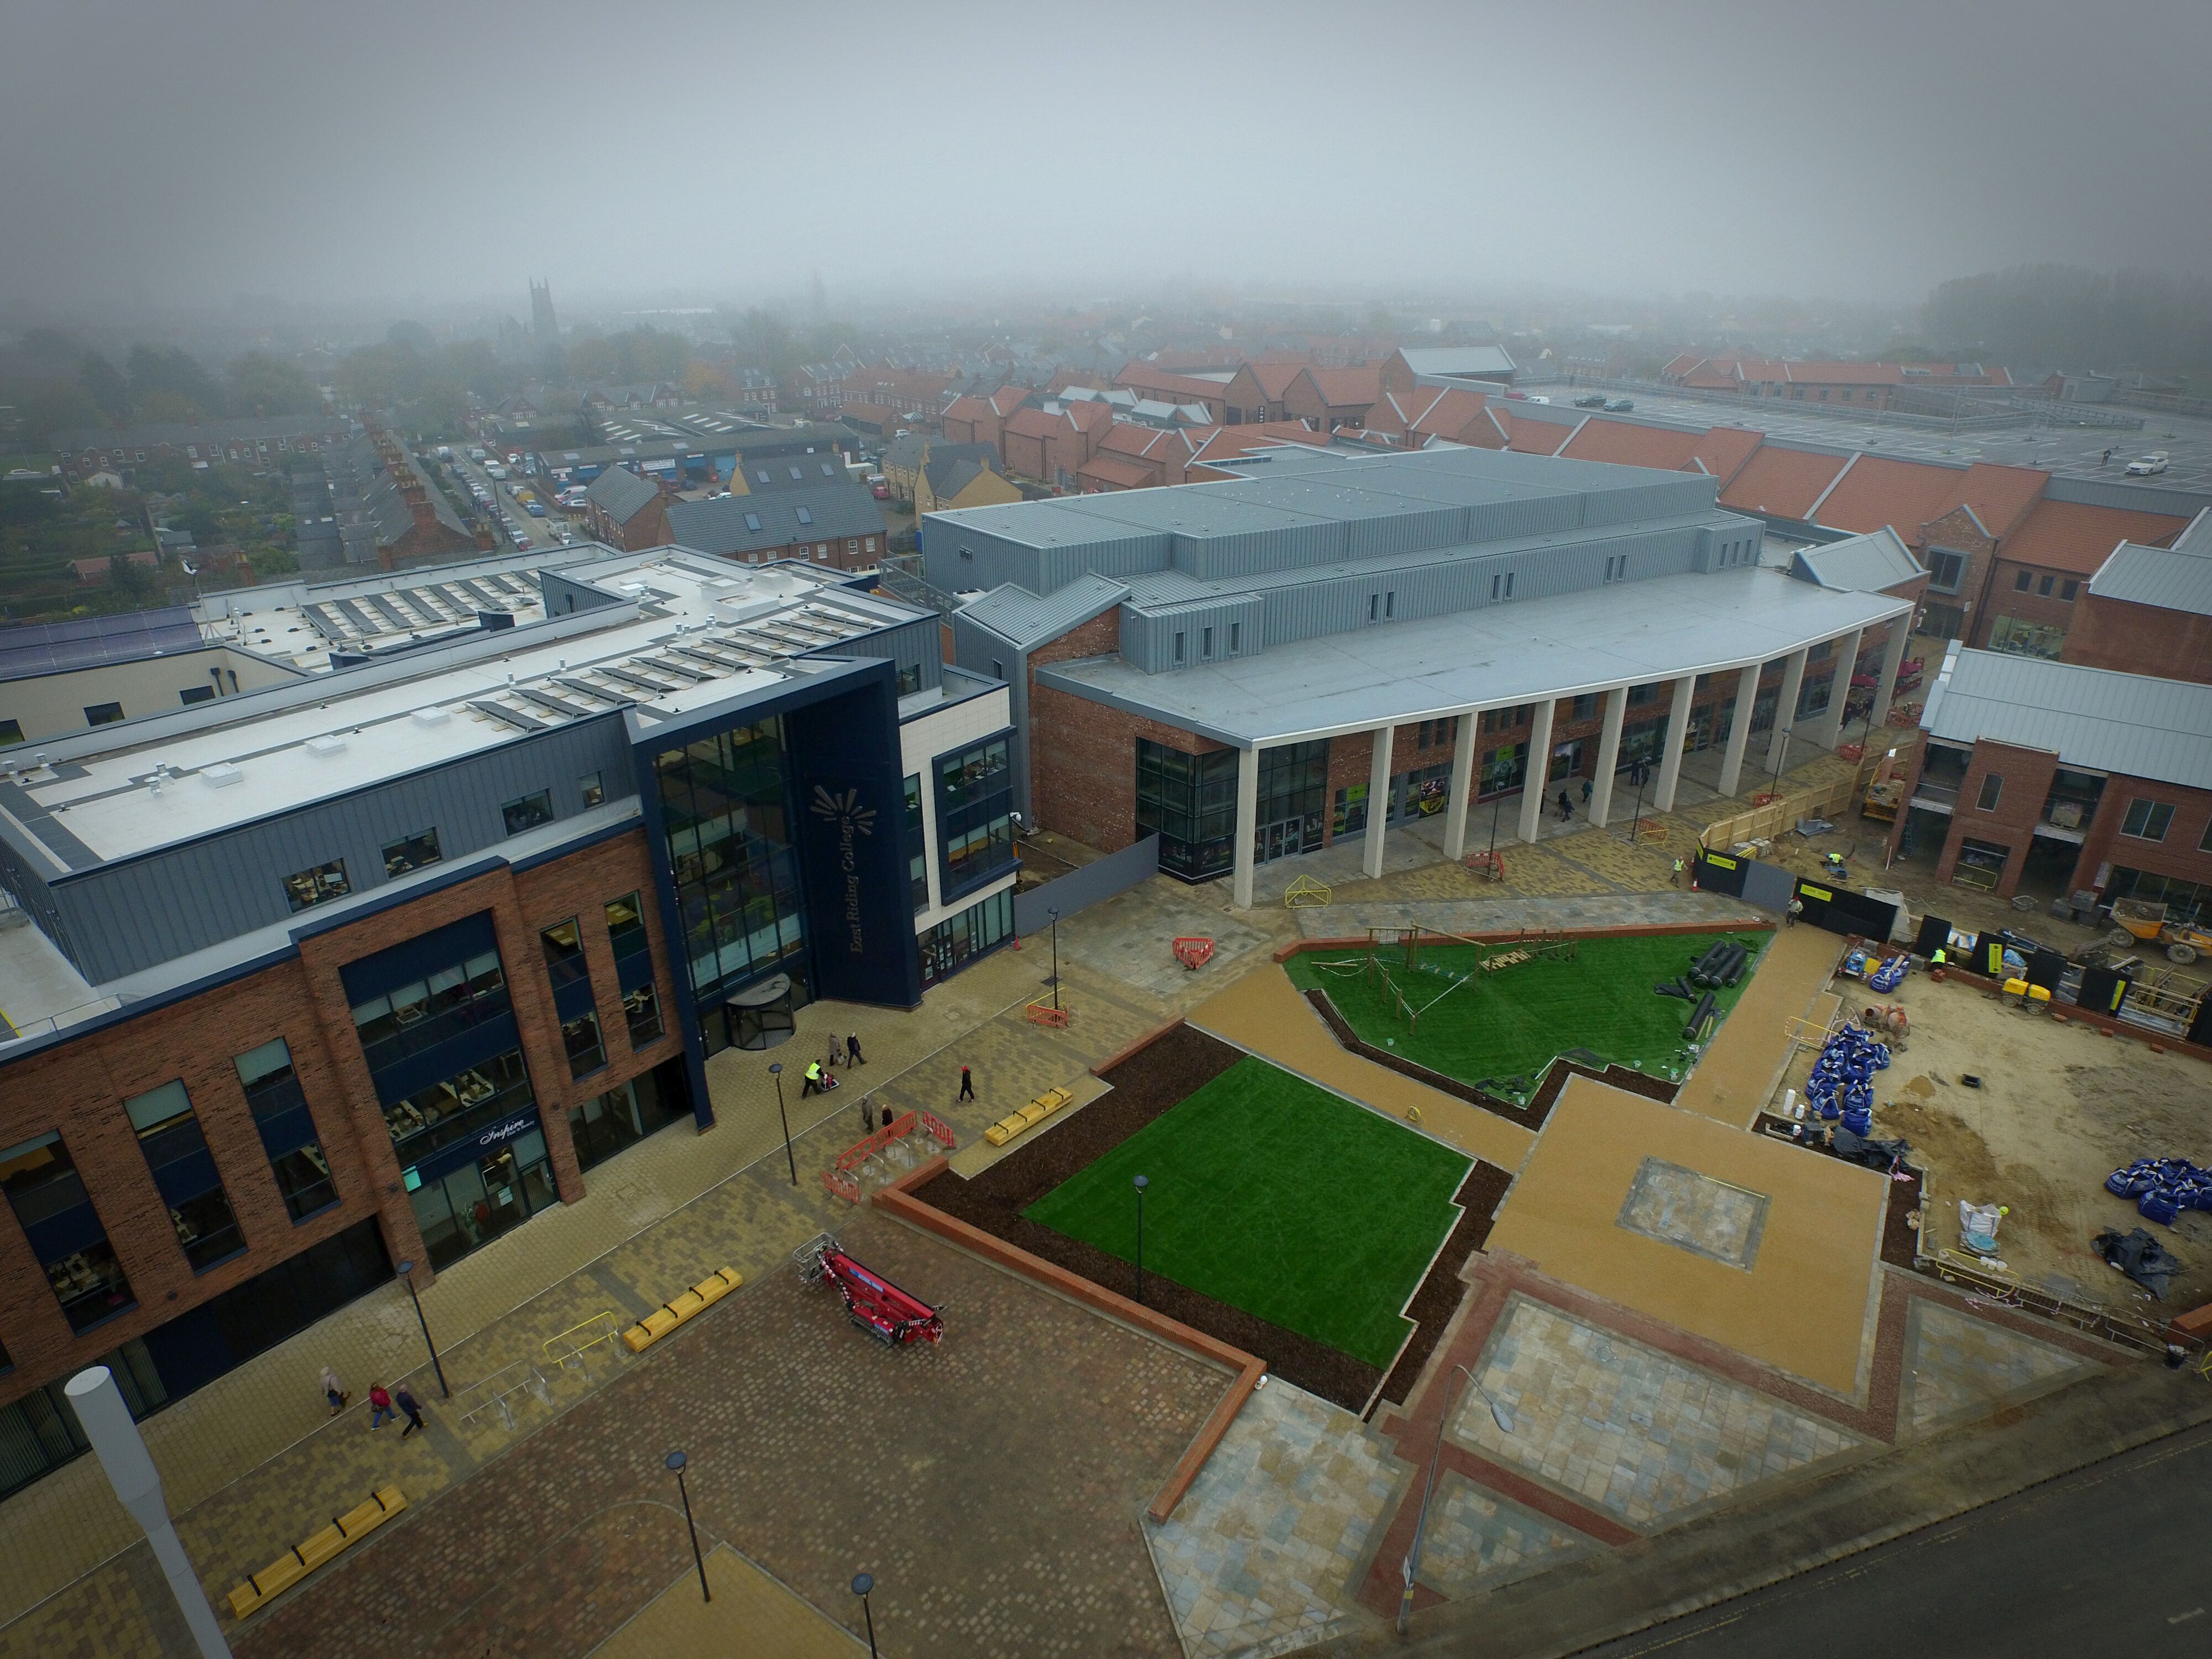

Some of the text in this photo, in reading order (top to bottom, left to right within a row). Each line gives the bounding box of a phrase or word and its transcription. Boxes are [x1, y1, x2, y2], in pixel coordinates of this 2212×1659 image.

[839, 816, 863, 953] East Riding College
[479, 1119, 524, 1145] Inspire
